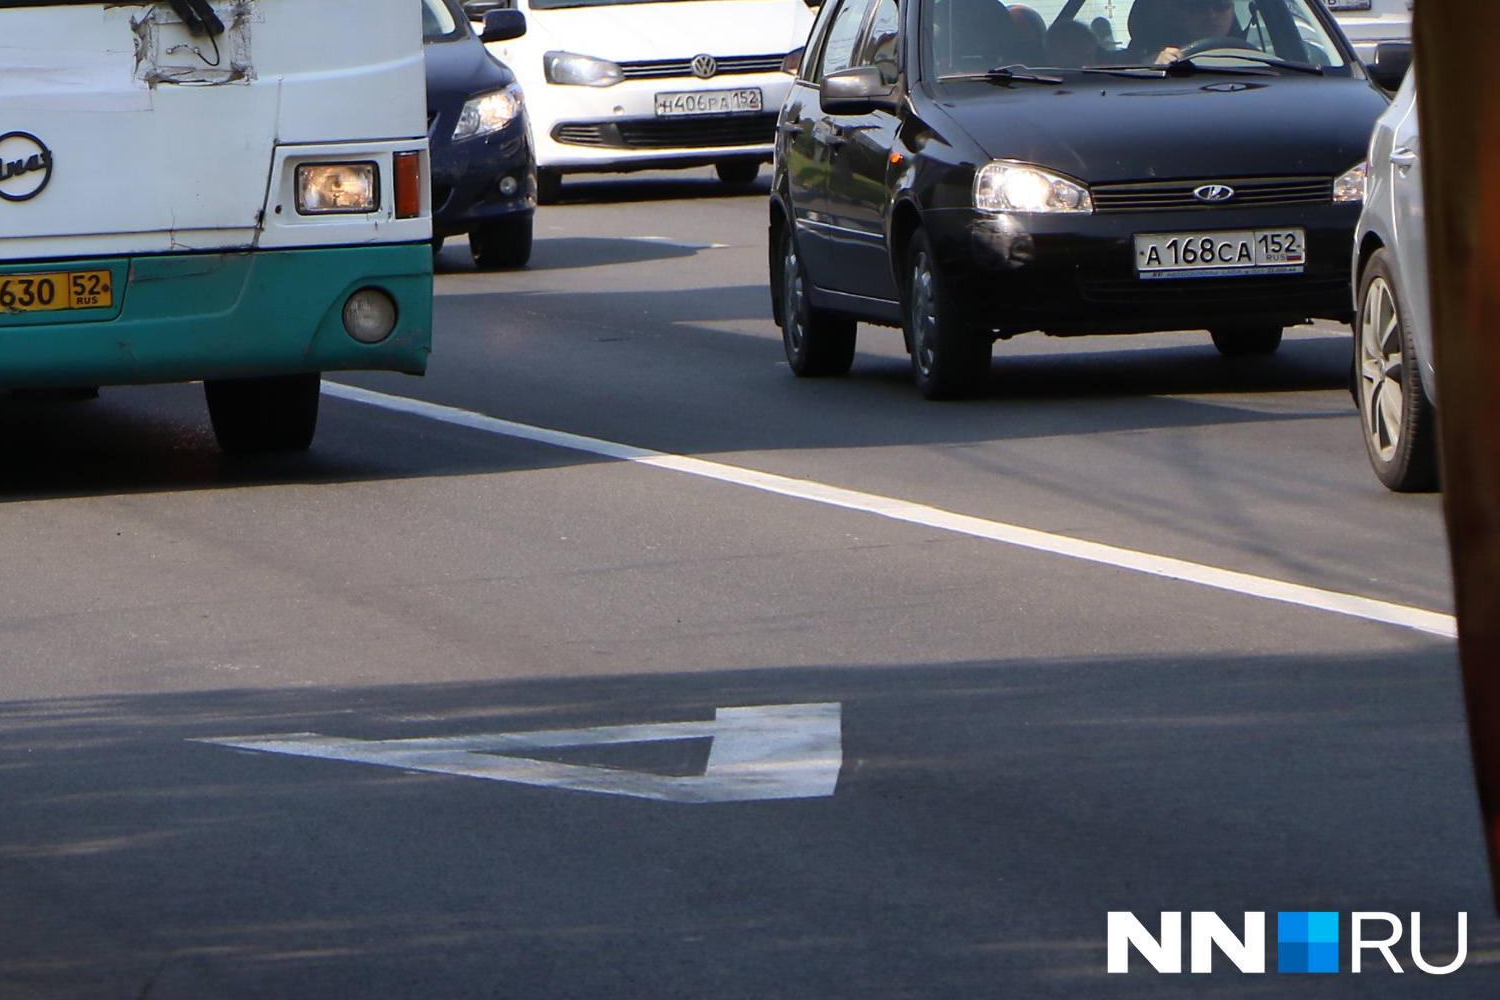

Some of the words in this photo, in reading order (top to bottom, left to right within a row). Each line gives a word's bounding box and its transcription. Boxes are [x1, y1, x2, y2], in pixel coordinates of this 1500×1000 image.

[1145, 236, 1252, 266] А168СА
[1257, 233, 1298, 255] 152
[1265, 253, 1287, 261] RUS
[72, 274, 101, 297] 52
[76, 296, 99, 306] RUS
